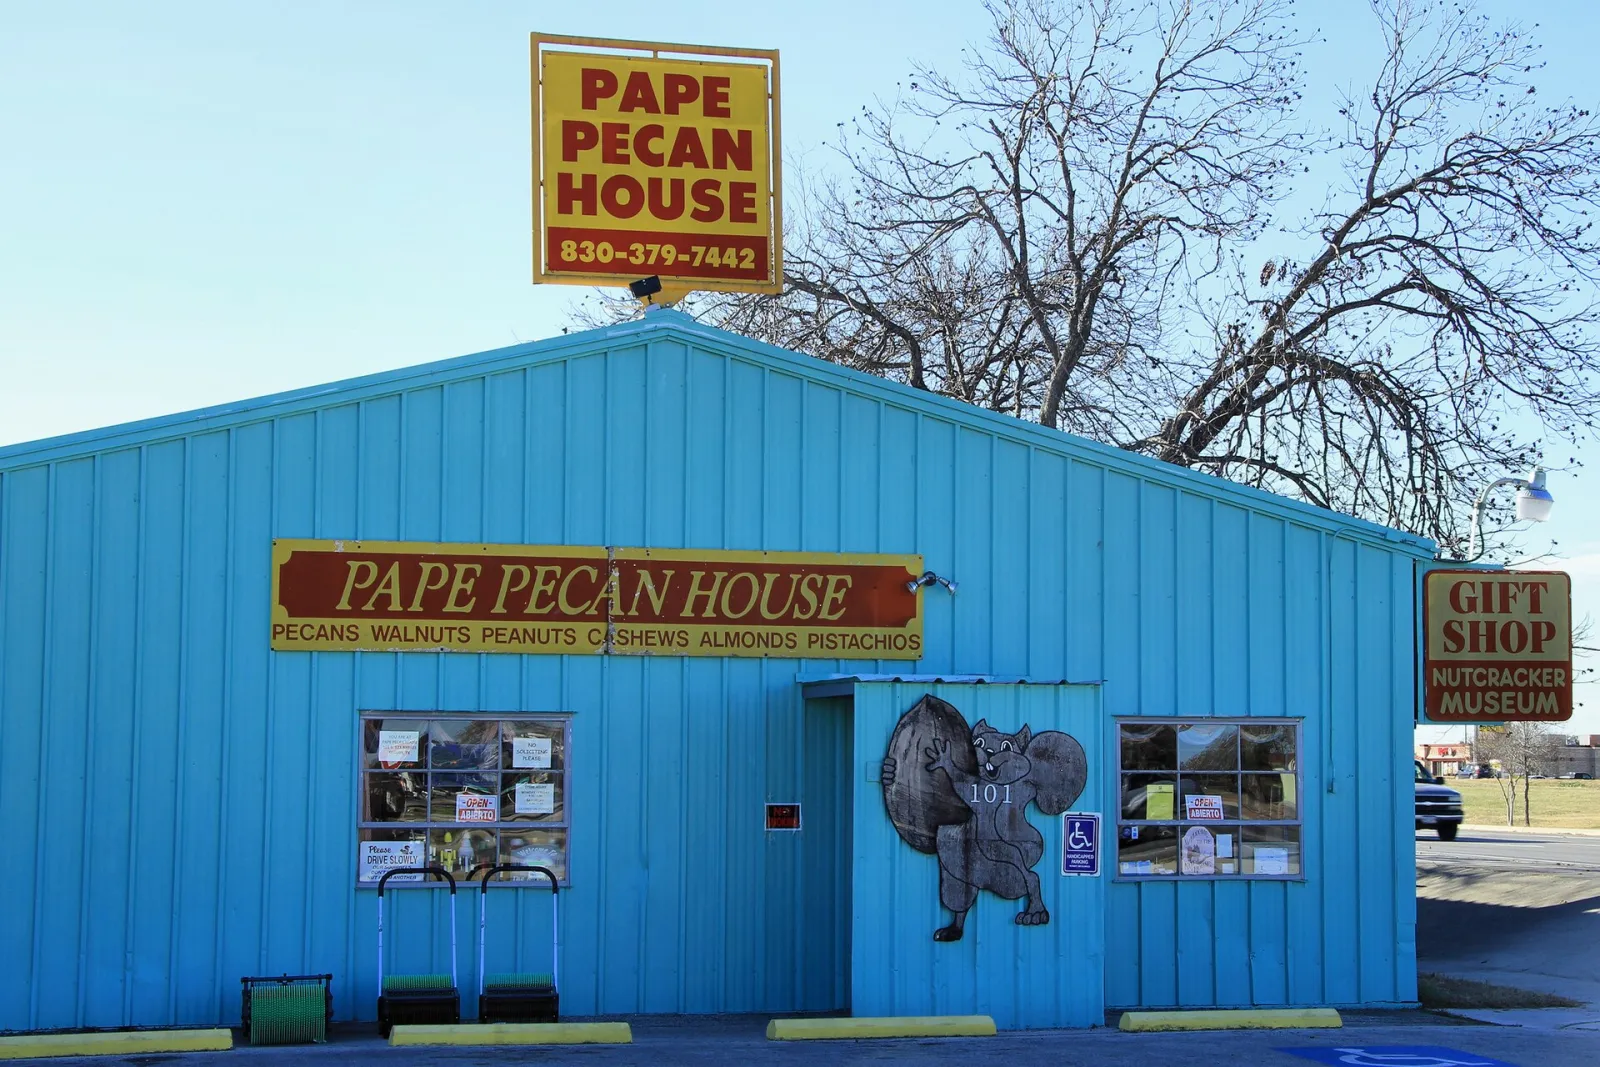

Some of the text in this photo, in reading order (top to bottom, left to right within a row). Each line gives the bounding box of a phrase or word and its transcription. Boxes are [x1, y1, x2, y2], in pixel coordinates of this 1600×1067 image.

[581, 67, 731, 118] PAPE
[562, 119, 753, 171] PECAN
[557, 172, 757, 224] HOUSE
[560, 240, 755, 269] 830-379-7442
[335, 560, 852, 620] PAPE PECAN HOUSE
[1449, 580, 1548, 614] GIFT
[272, 624, 921, 651] PECANS WALNUTS PEANUTS CASHEWS ALMONDS PISTACHIOS
[1442, 620, 1556, 654] SHOP
[1432, 667, 1566, 688] NUTCRACKER
[1440, 691, 1559, 715] MUSEUM
[970, 783, 1013, 804] 101
[460, 810, 494, 820] ABIERTO
[1191, 808, 1220, 818] ABIERTO
[367, 855, 418, 865] DRIVE SLOWLY
[368, 845, 392, 854] Please
